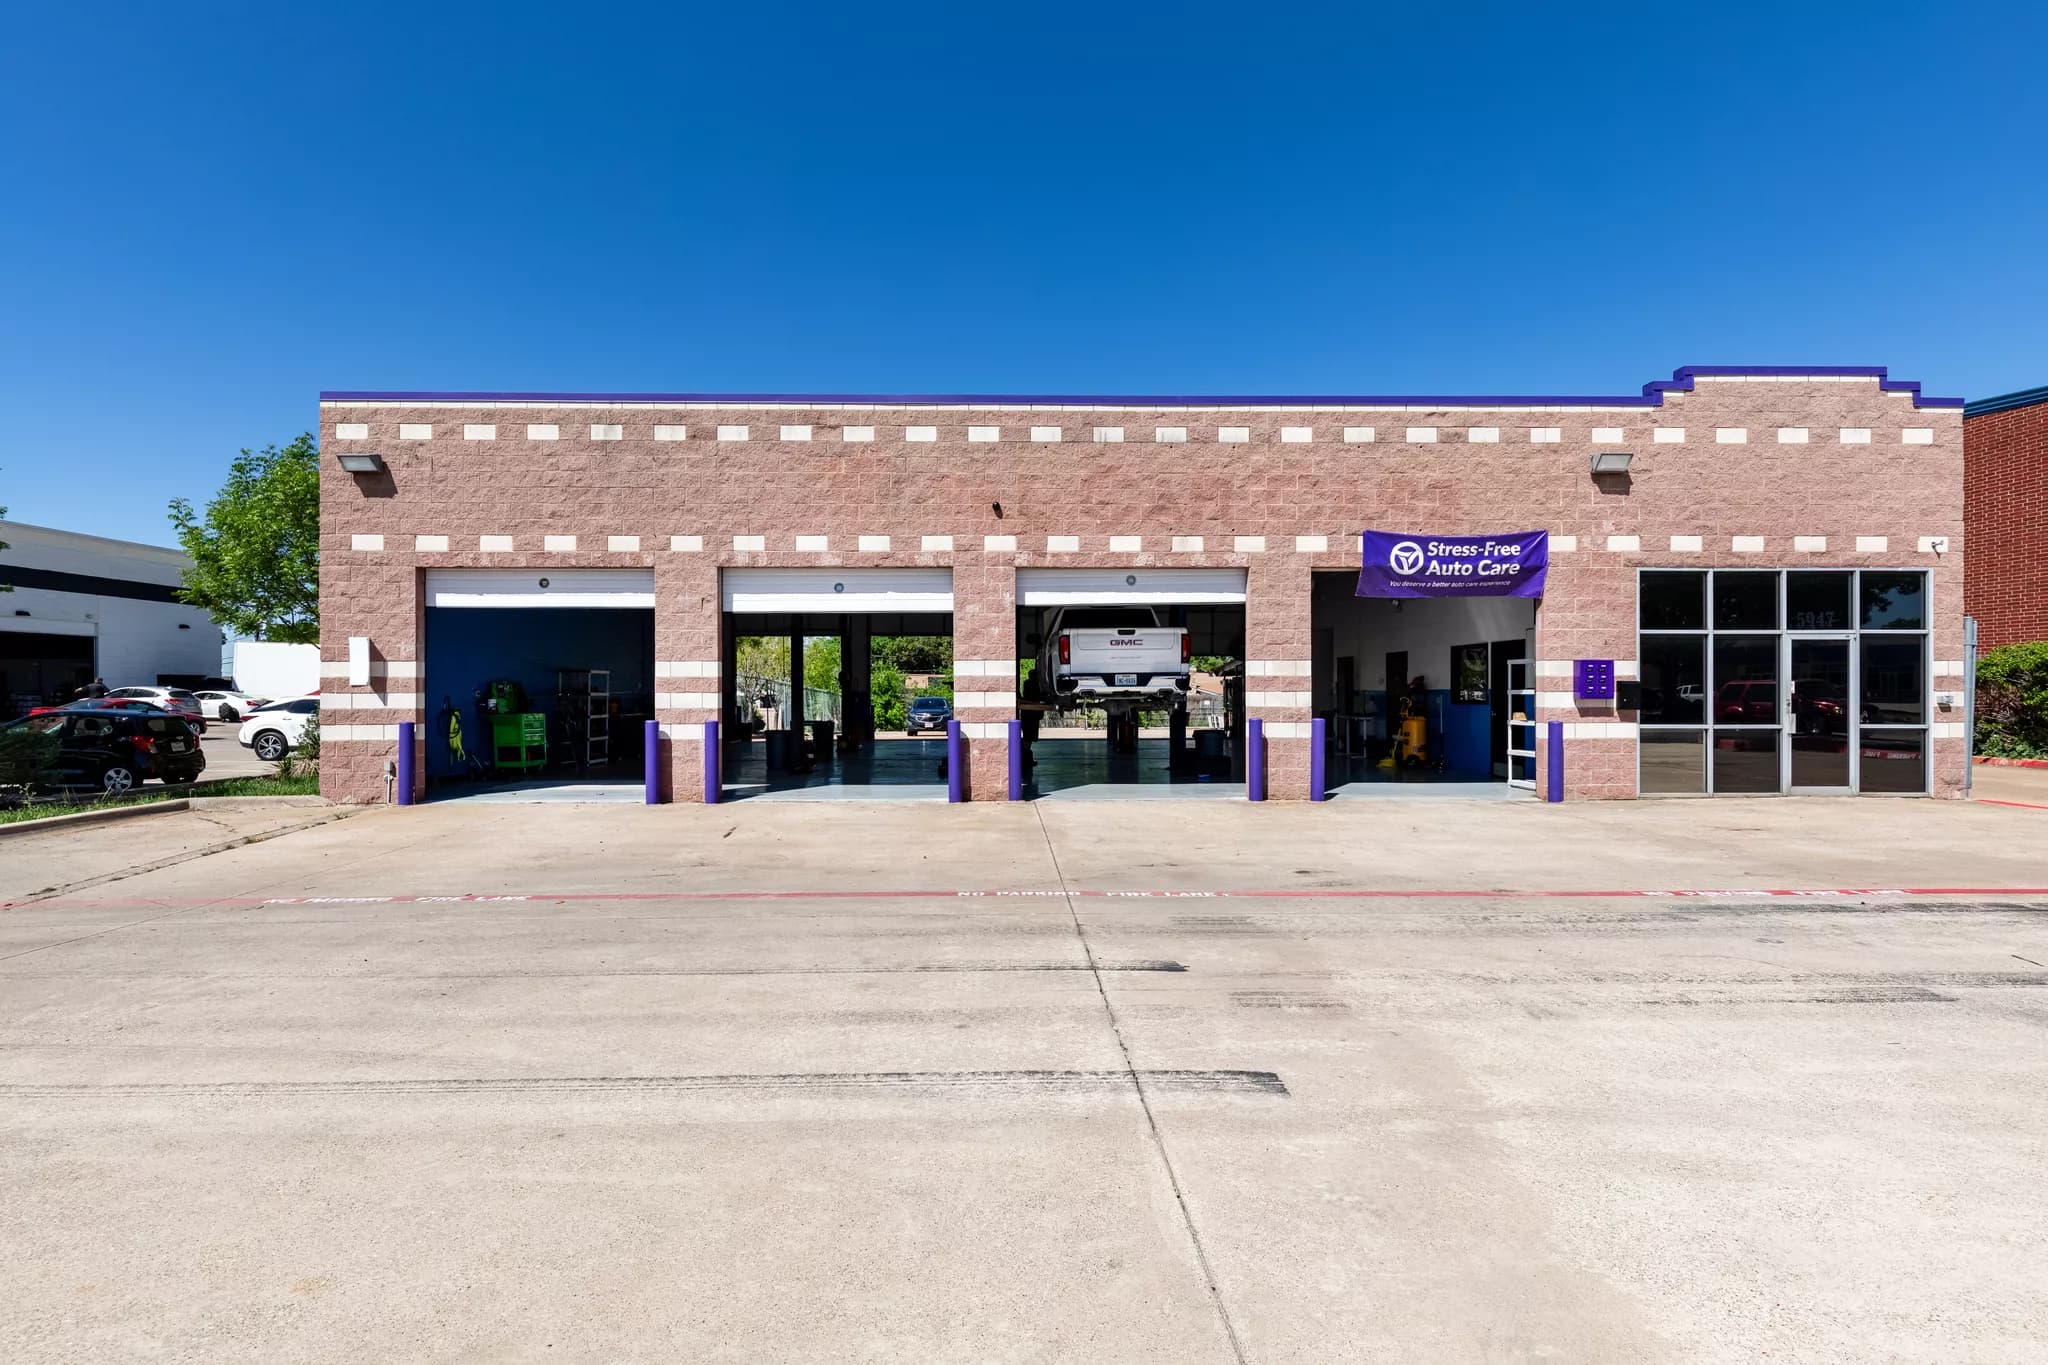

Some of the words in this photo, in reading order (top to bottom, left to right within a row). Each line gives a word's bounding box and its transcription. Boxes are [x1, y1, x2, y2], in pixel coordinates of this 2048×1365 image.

[1427, 541, 1521, 557] Stress-Free
[1425, 560, 1473, 576] Auto
[1477, 559, 1521, 576] Care
[1402, 580, 1426, 588] deserve
[1432, 580, 1450, 588] better
[1796, 610, 1834, 627] 5947
